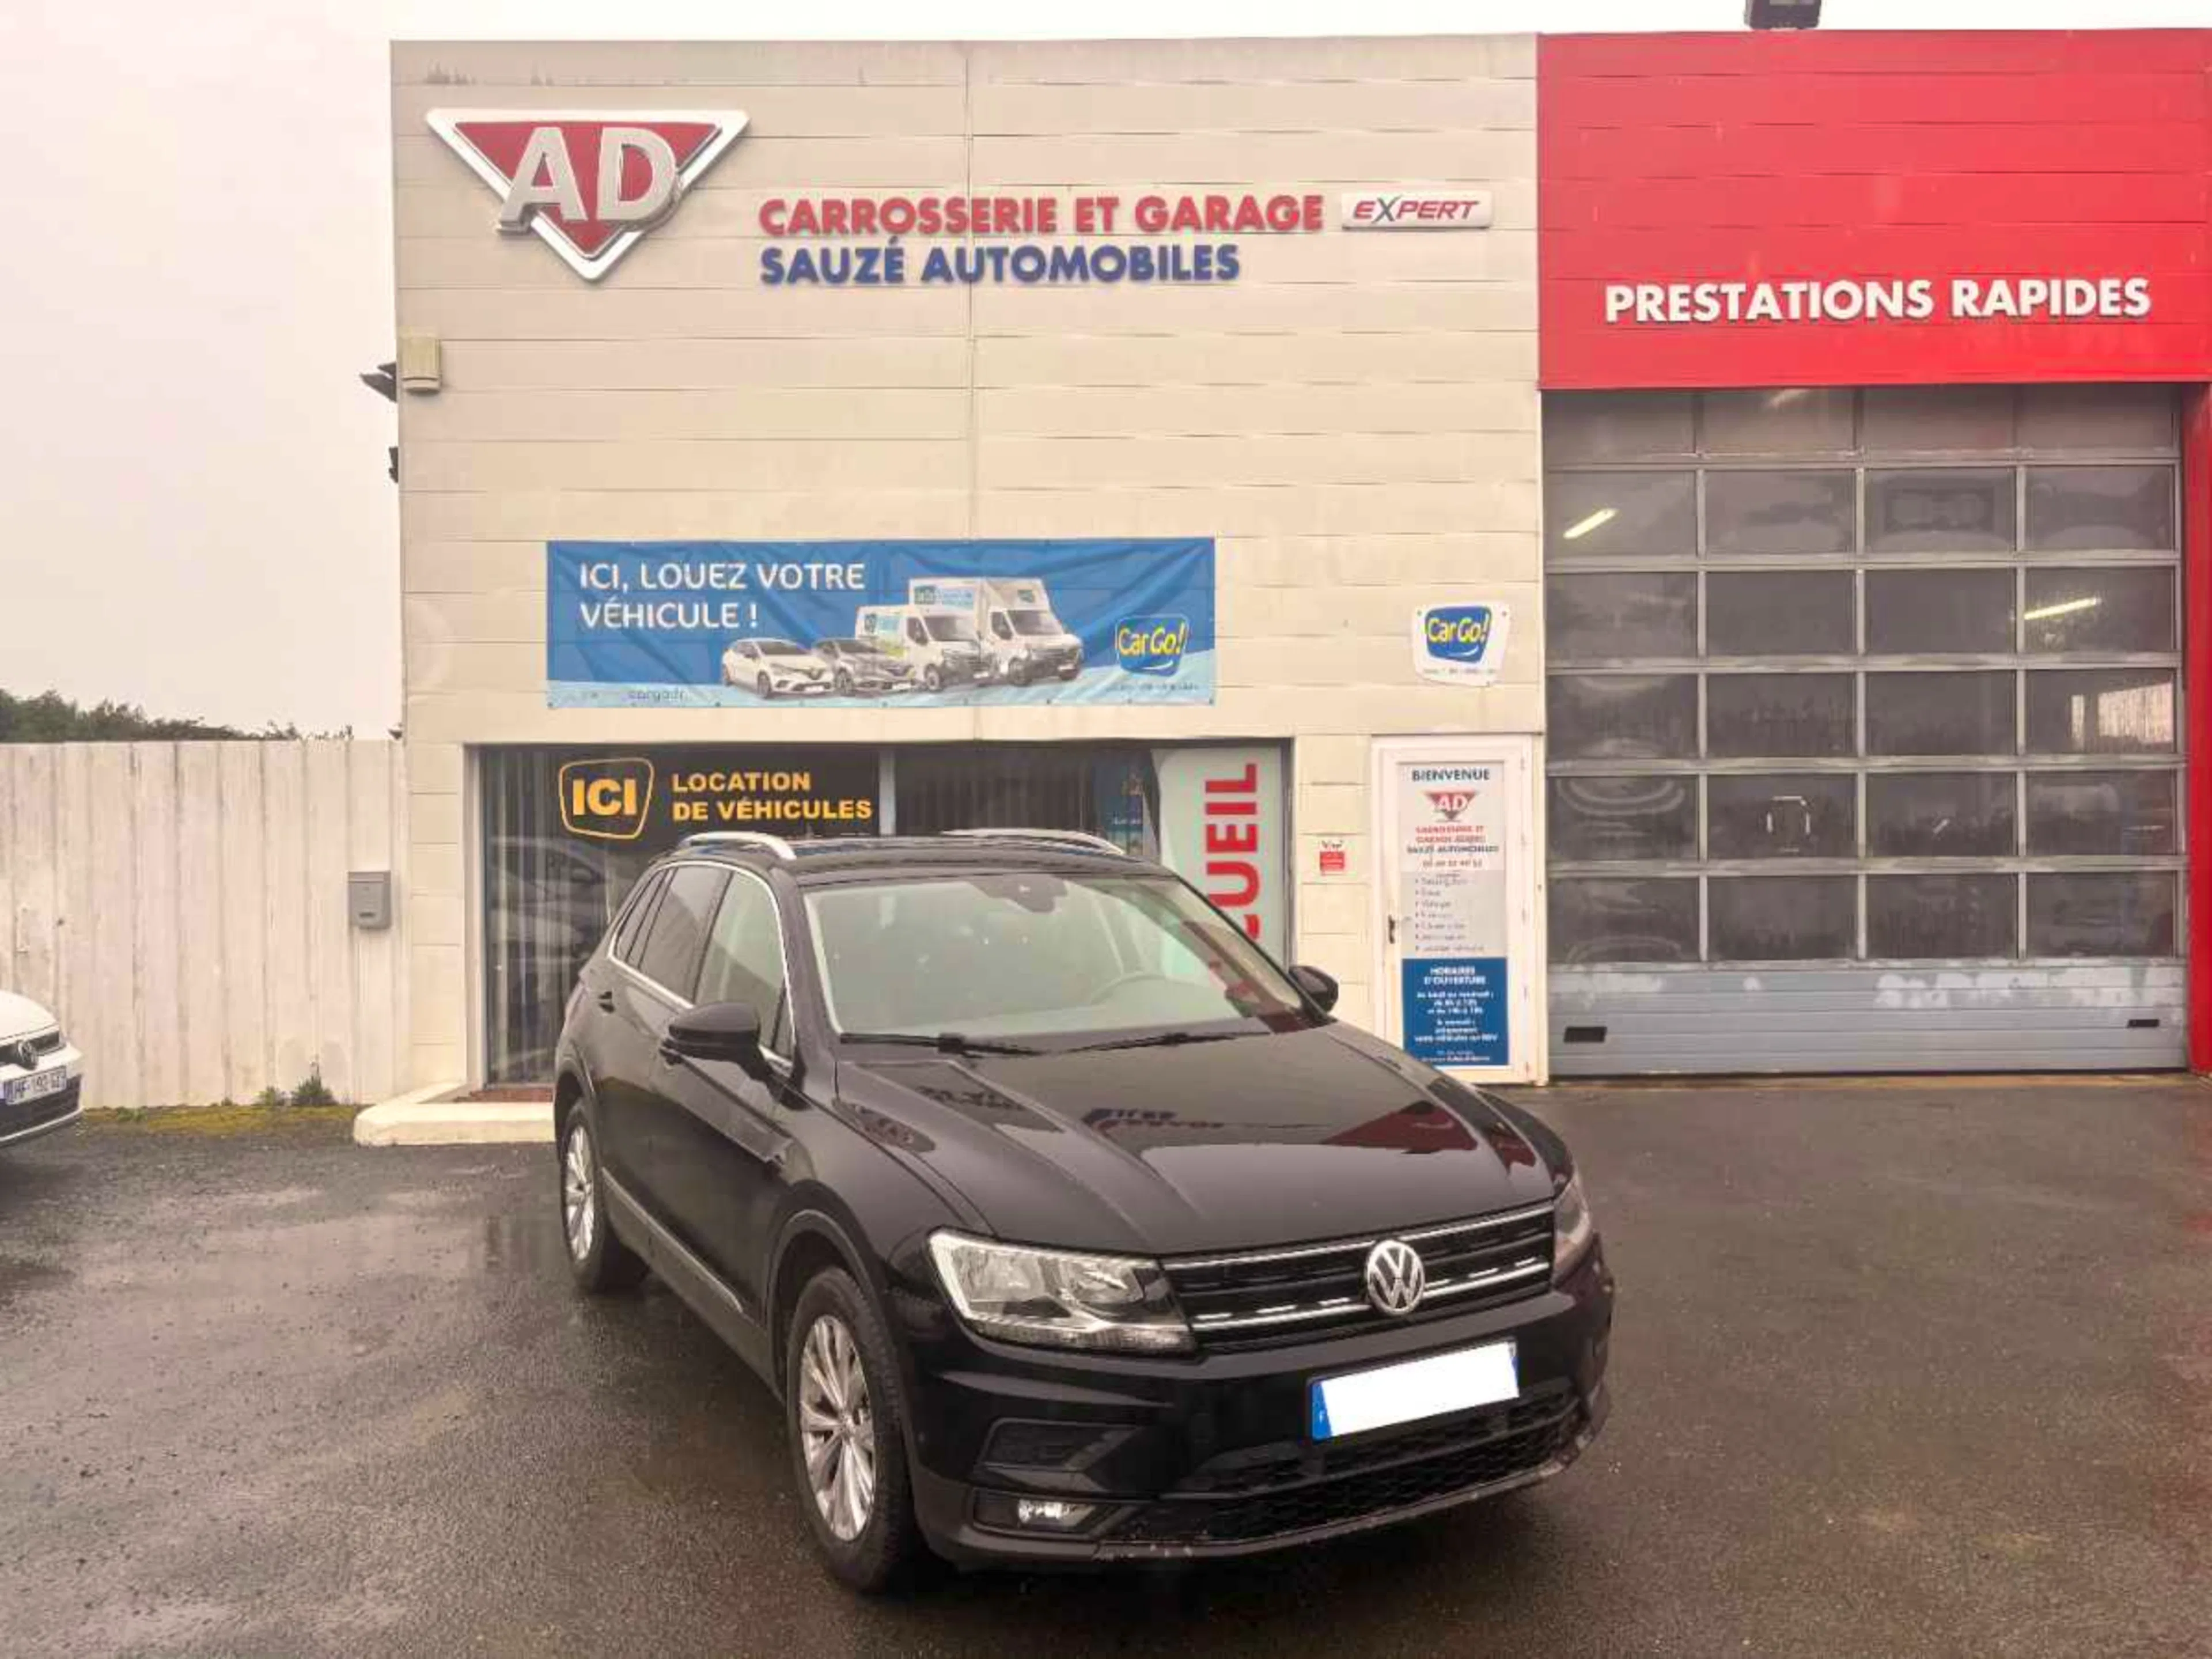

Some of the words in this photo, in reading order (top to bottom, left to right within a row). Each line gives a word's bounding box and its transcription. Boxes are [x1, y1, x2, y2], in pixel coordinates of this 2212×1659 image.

[497, 126, 680, 232] AD
[758, 198, 1058, 234] CARROSSERIE
[1074, 196, 1120, 232] ET
[1135, 195, 1324, 232] GARAGE
[1353, 195, 1480, 224] EXPERT
[760, 236, 905, 283] SAUZÉ
[921, 244, 1240, 283] AUTOMOBILES
[1605, 281, 1933, 322] PRESTATIONS
[1952, 278, 2152, 316] RAPIDES
[581, 563, 629, 592] ICI,
[639, 562, 748, 590] LOUEZ
[756, 563, 866, 590] VOTRE
[581, 597, 740, 629] VÉHICULE
[751, 602, 757, 628] !
[672, 772, 810, 793] LOCATION
[1412, 769, 1490, 781] BIENVENUE
[573, 778, 637, 816] ICI
[673, 801, 709, 821] DE
[718, 797, 873, 820] VÉHICULES
[1437, 794, 1468, 811] AD
